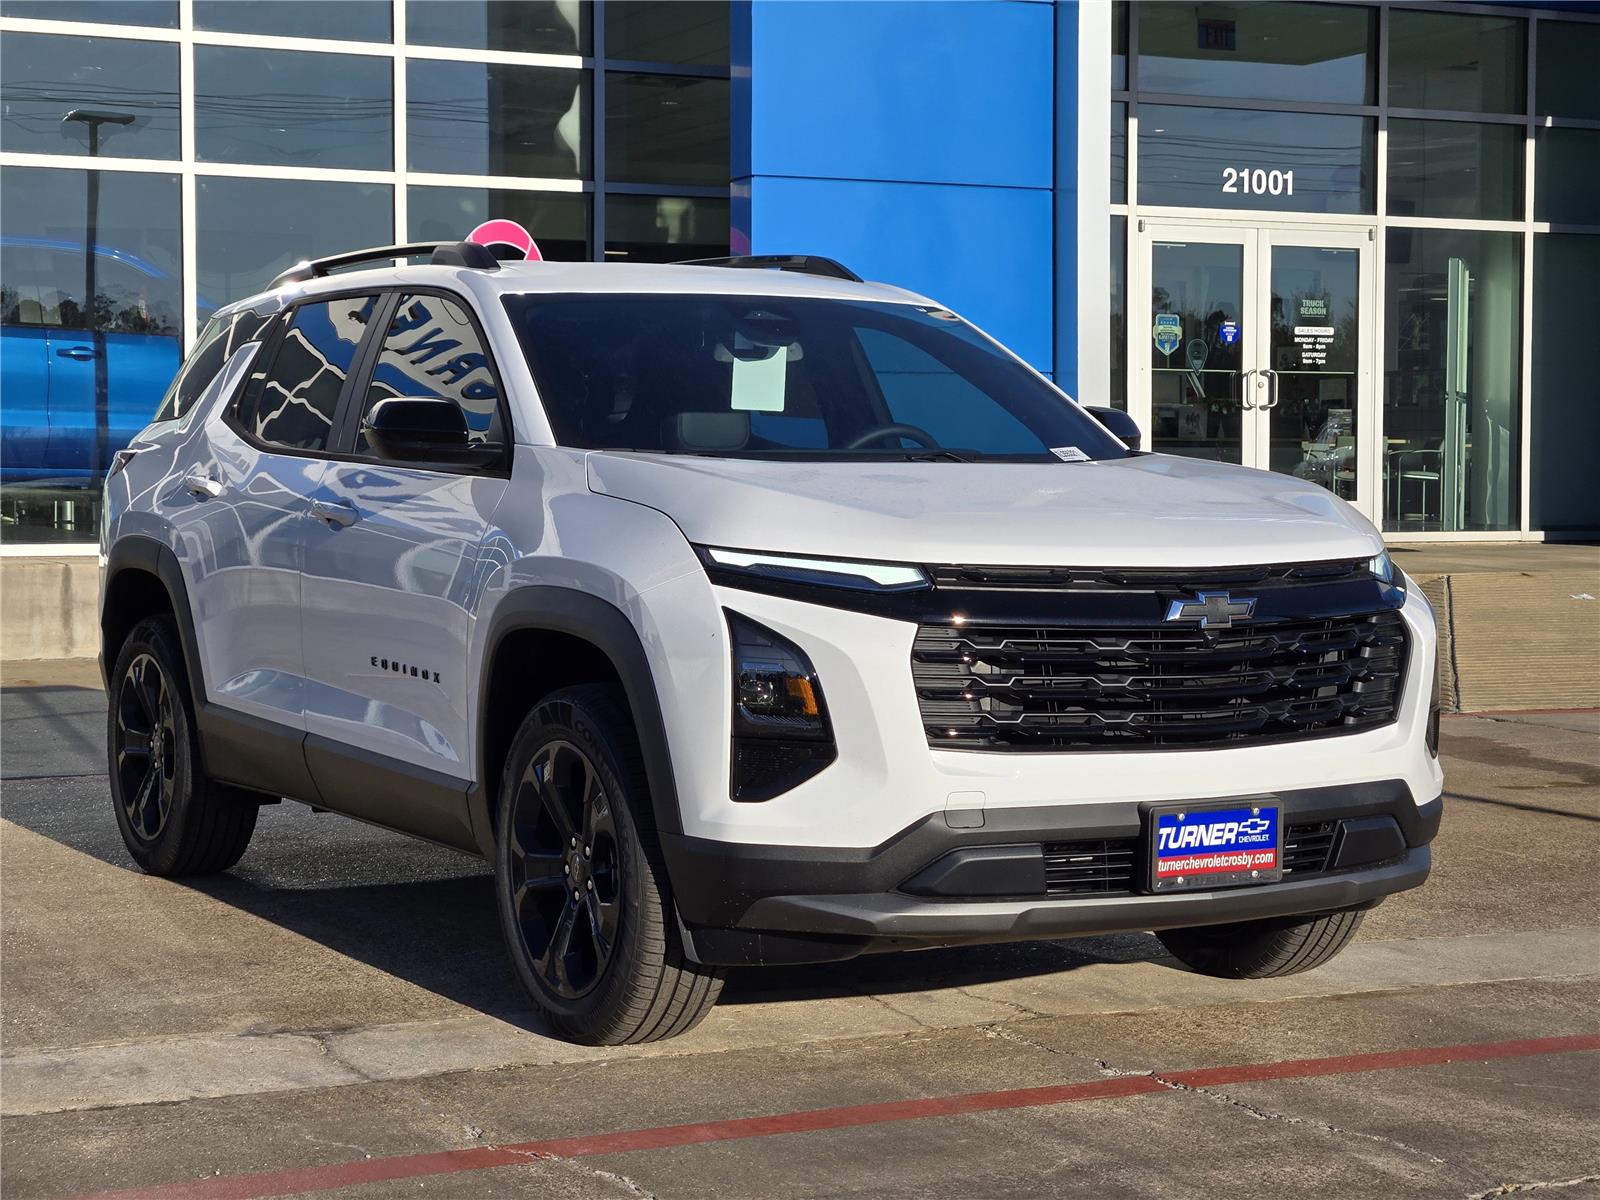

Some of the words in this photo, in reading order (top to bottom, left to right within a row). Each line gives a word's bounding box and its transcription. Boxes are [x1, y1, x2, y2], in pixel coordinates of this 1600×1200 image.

[1222, 167, 1293, 196] 21001
[1300, 307, 1327, 315] SEASON
[370, 656, 441, 684] EQUINOX
[1159, 822, 1239, 850] TURNER
[1238, 833, 1269, 843] CHEVROLET
[1158, 852, 1274, 872] turnerchevroletcrosby.com
